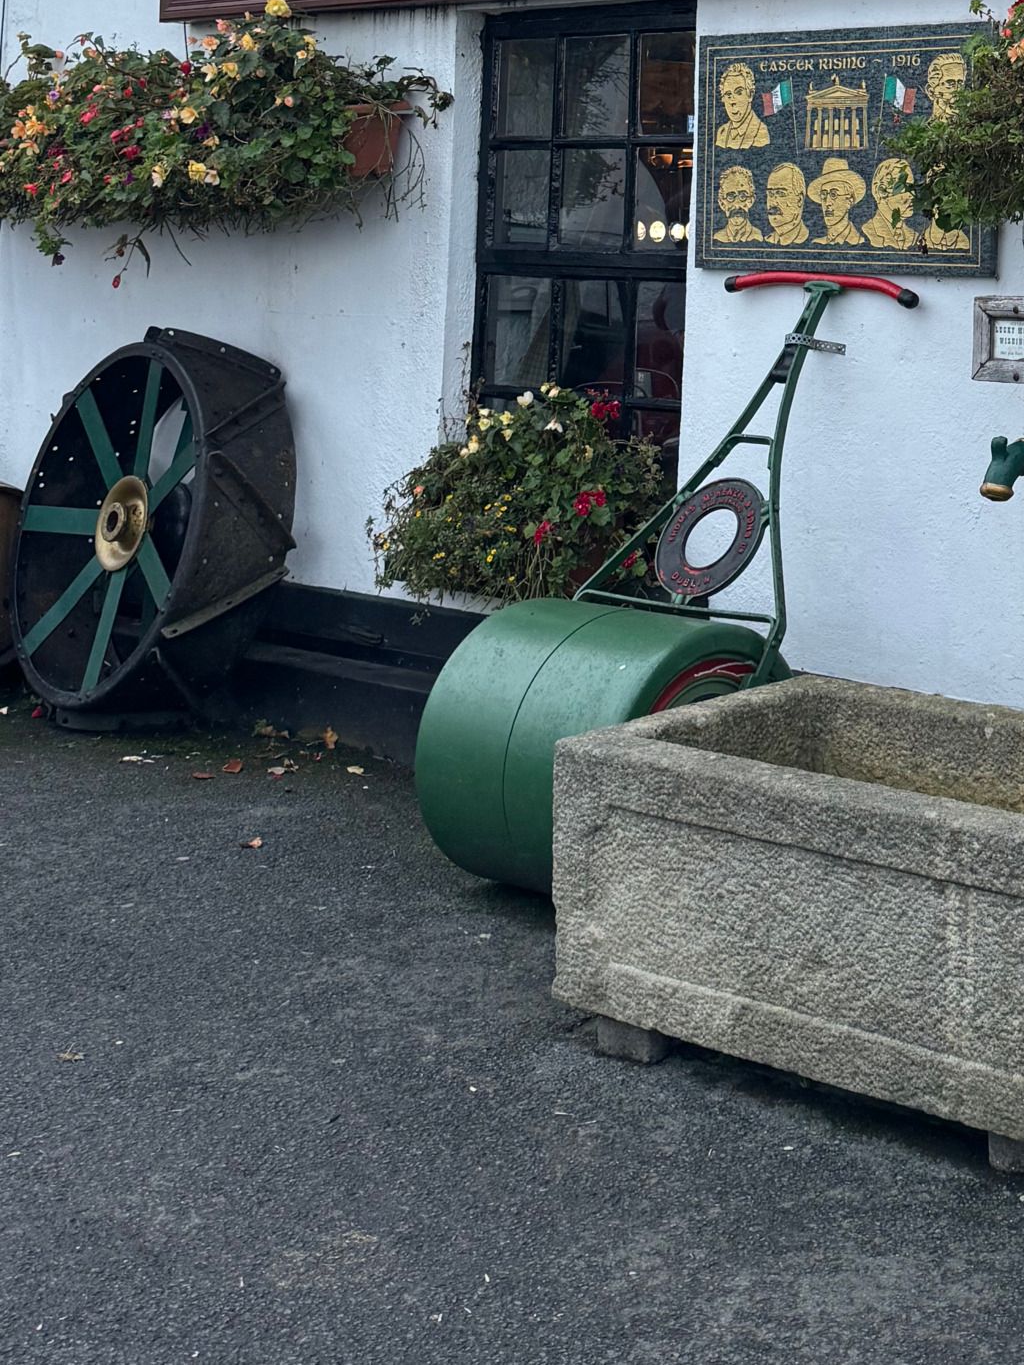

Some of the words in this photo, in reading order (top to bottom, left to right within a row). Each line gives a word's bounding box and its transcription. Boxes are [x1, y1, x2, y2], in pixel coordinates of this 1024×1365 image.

[760, 58, 814, 72] EASTER
[819, 56, 866, 70] RISING
[891, 54, 921, 67] 1916
[671, 571, 711, 588] DUBLIN
